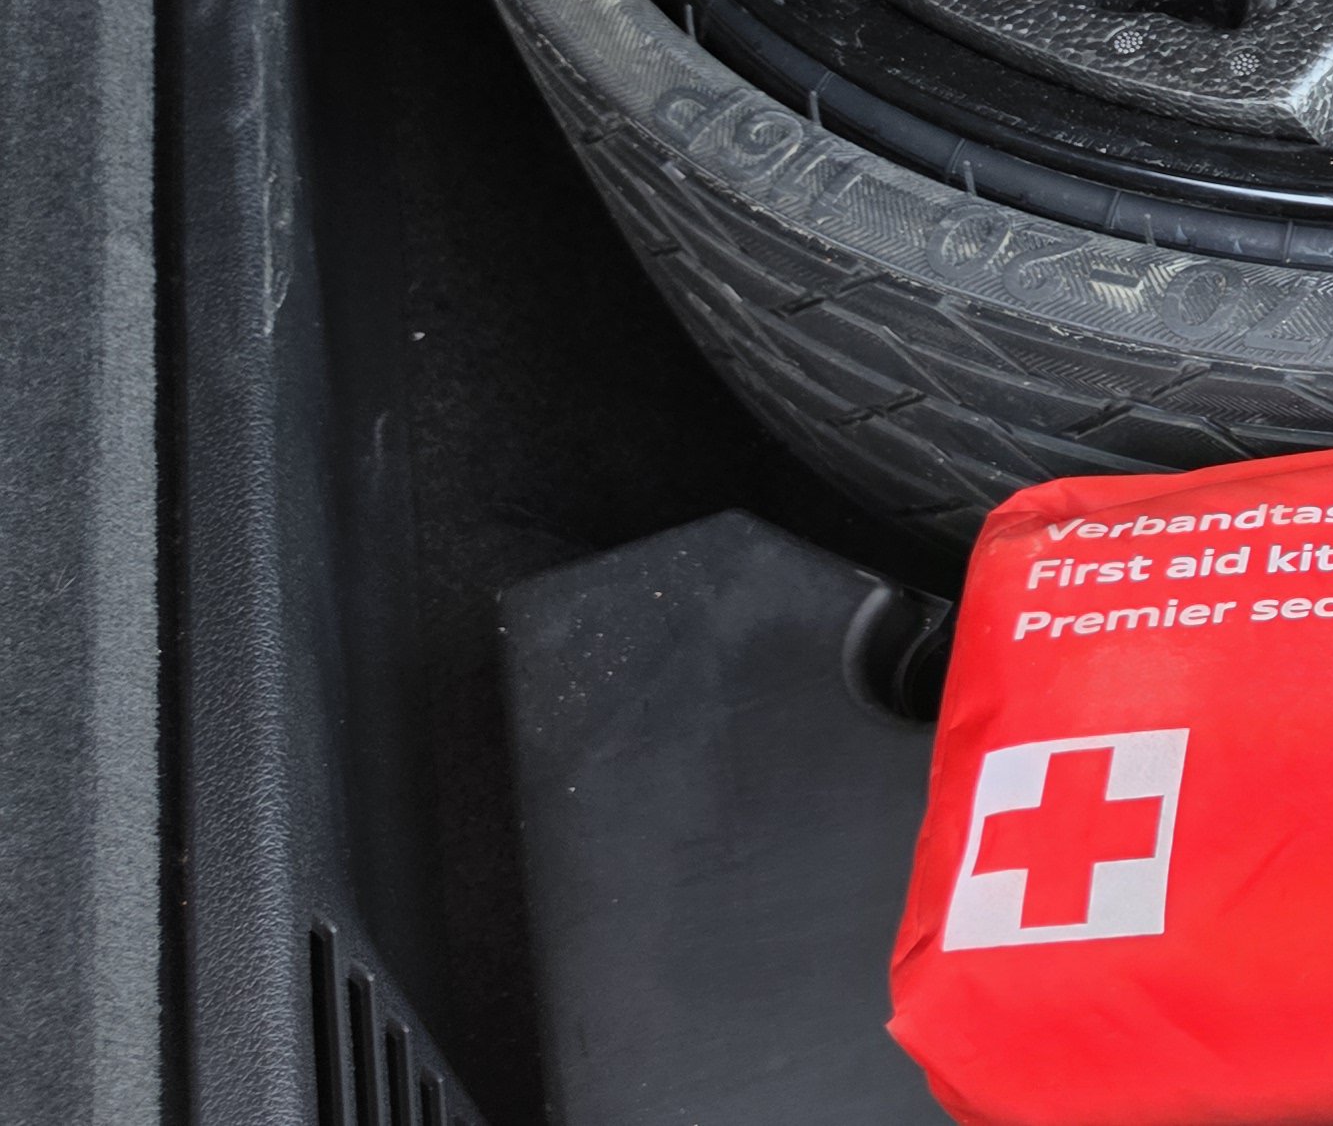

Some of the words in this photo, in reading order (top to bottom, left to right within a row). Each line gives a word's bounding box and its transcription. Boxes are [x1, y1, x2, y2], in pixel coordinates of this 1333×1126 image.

[1027, 553, 1151, 590] First
[1166, 546, 1250, 579] aid
[1013, 598, 1237, 641] Premier
